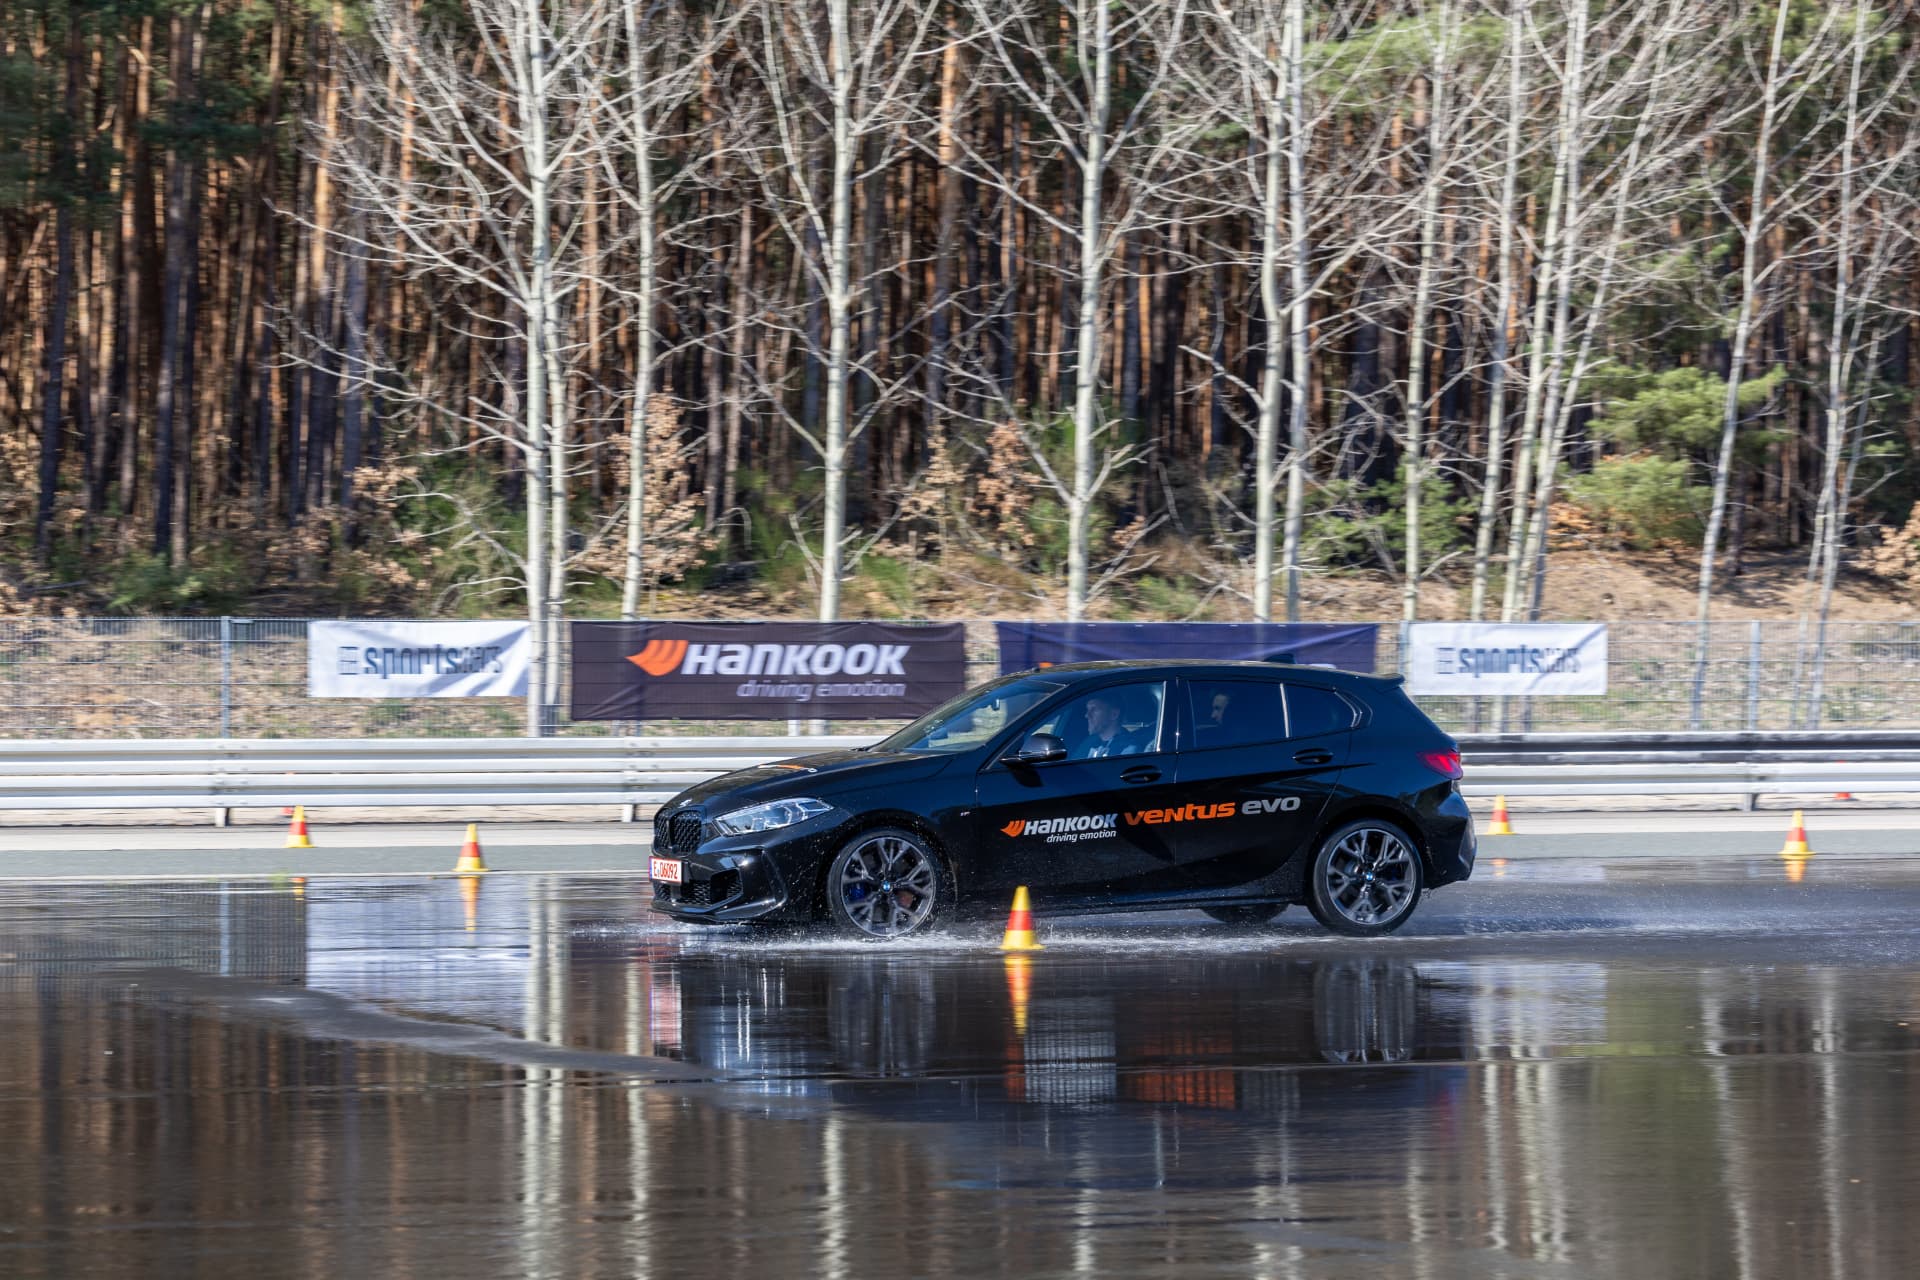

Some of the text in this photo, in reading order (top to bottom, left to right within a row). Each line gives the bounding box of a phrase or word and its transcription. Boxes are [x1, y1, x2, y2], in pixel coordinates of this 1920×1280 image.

[736, 681, 906, 701] driving emotion
[1045, 829, 1117, 844] driving emotion
